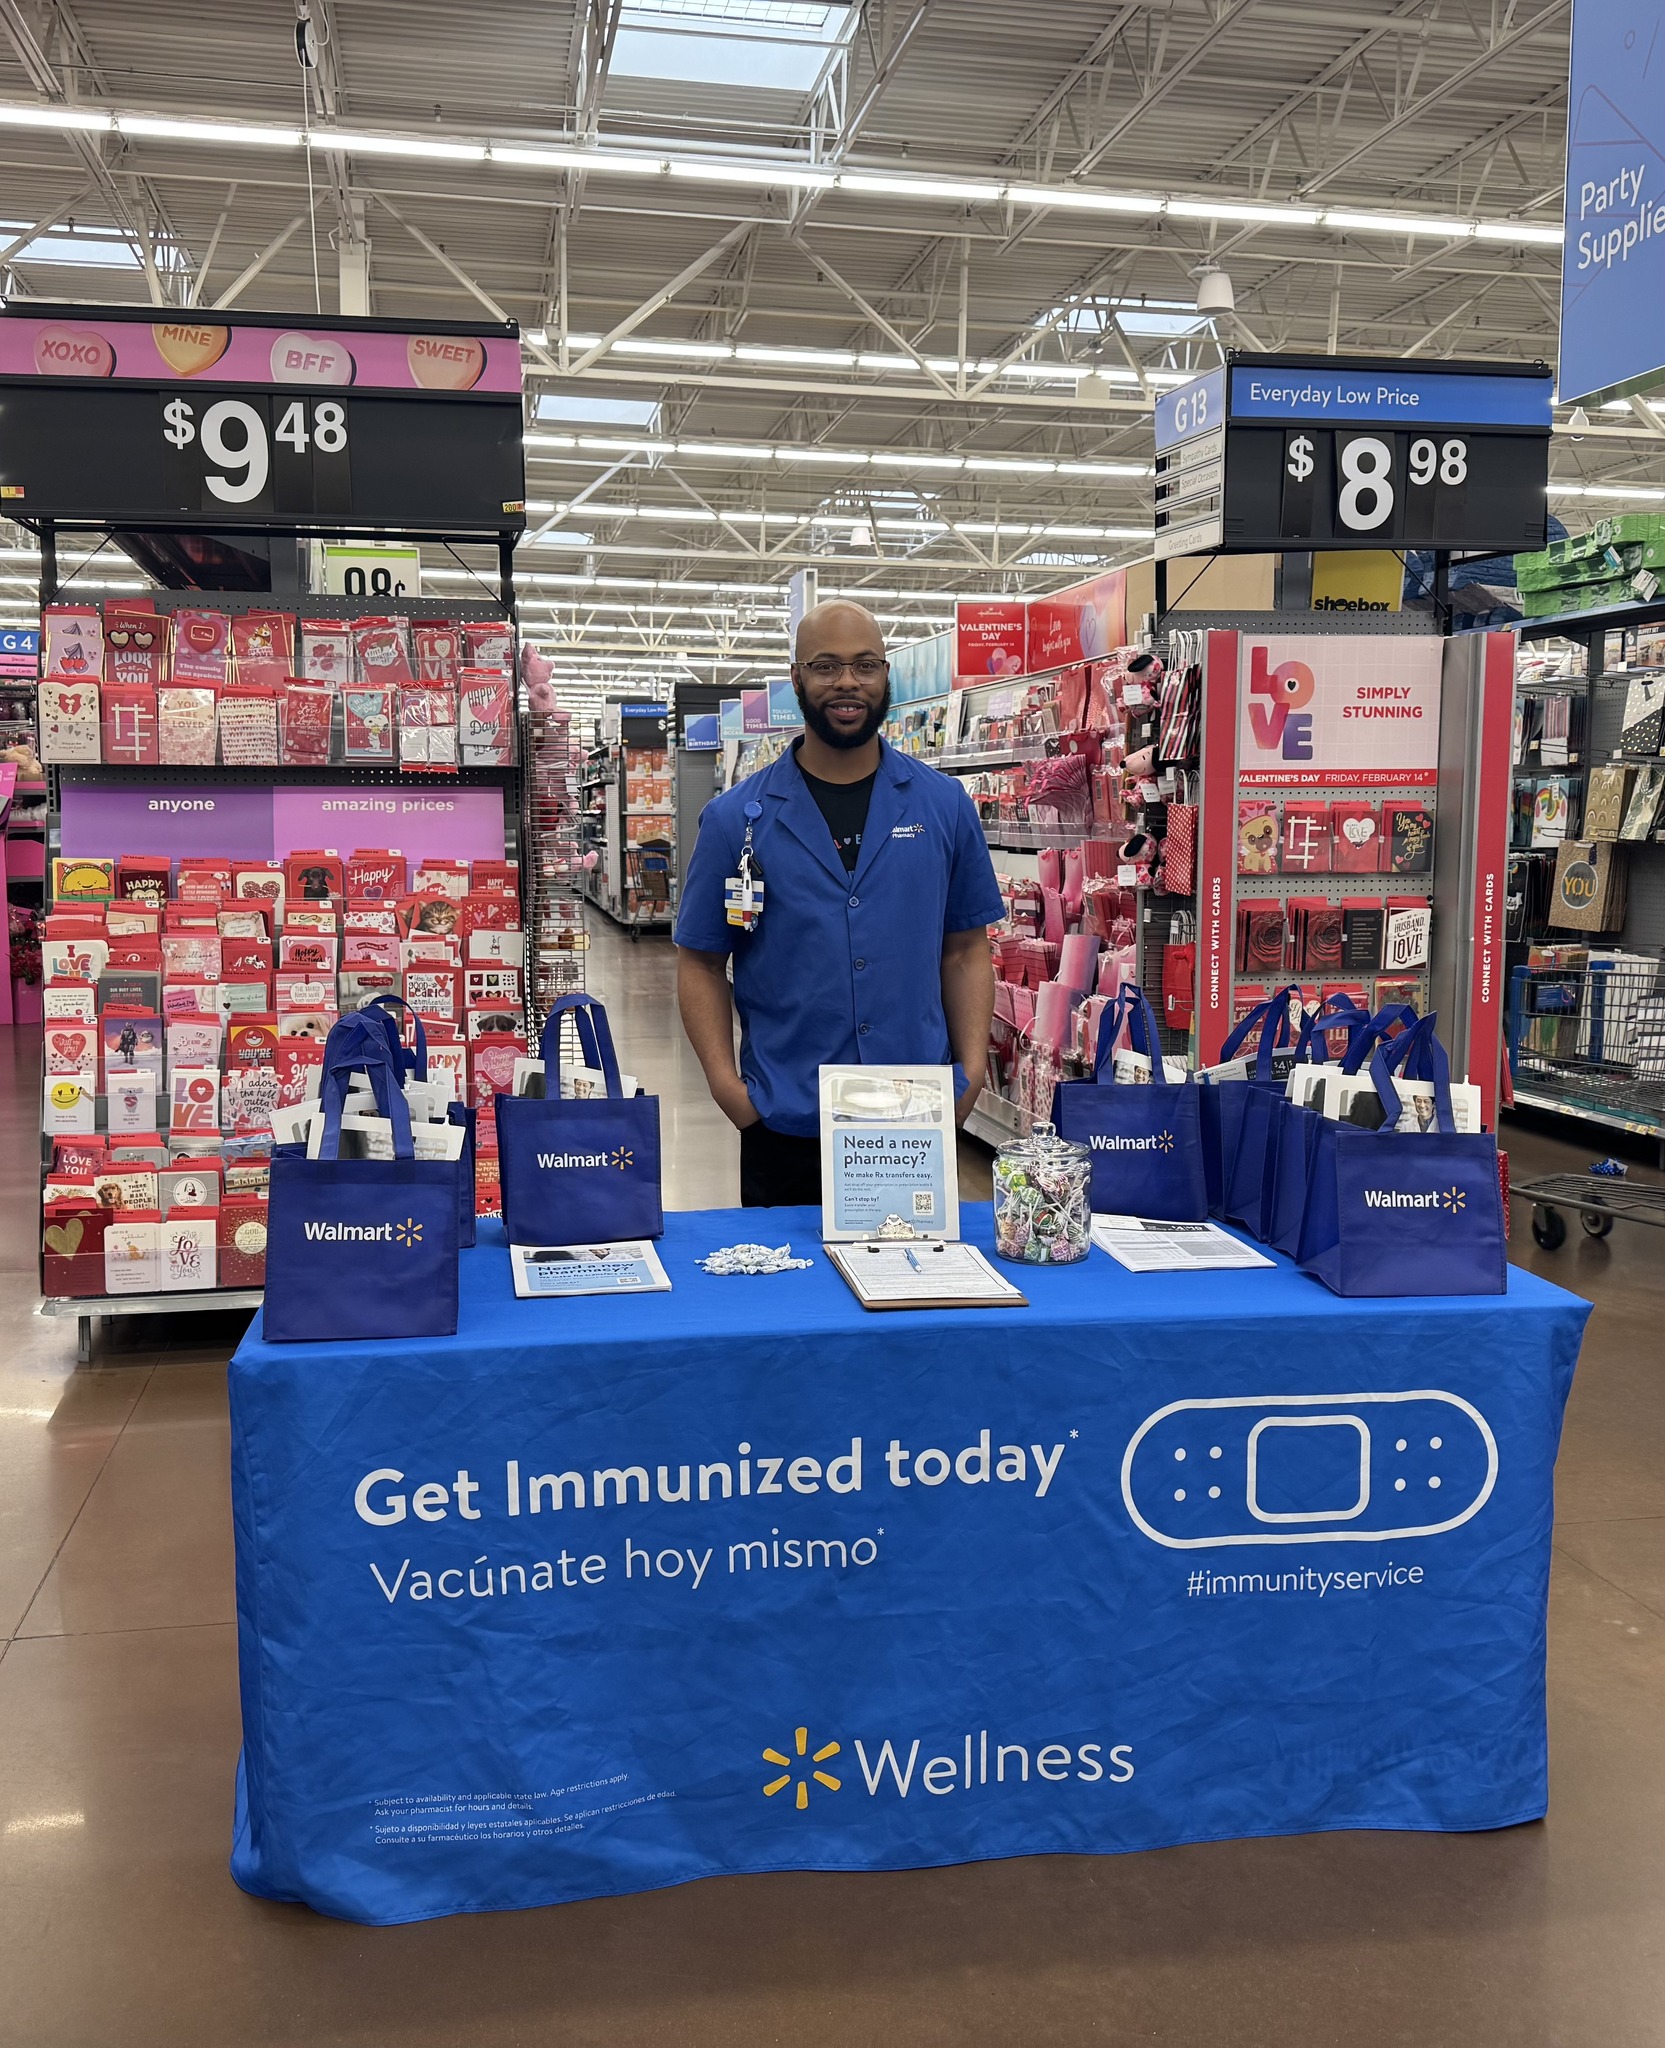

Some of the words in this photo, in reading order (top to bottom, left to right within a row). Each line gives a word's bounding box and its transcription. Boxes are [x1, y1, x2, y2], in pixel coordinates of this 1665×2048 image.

[1579, 163, 1645, 222] Party
[161, 325, 212, 347] MINE
[41, 339, 101, 365] XOXO
[413, 338, 475, 365] SWEET
[284, 349, 335, 374] BFF
[1251, 382, 1331, 407] Everyday
[1336, 384, 1373, 404] Low
[1376, 387, 1420, 406] Price
[1204, 443, 1218, 455] Cards
[1181, 473, 1198, 491] Special
[1198, 469, 1218, 484] Occasion
[1168, 539, 1188, 551] Greeting
[1188, 533, 1203, 545] Cards
[1314, 595, 1391, 612] shoebox
[119, 622, 137, 630] When
[960, 623, 1023, 632] VALENTINE'S
[981, 632, 1001, 641] DAY
[114, 651, 153, 669] LOOK
[179, 662, 194, 670] The
[1356, 686, 1411, 699] SIMPLY
[1342, 706, 1423, 719] STUNNING
[172, 720, 205, 729] LOVED
[657, 719, 666, 731] $
[1239, 773, 1300, 784] VALENTINE'S
[1301, 773, 1320, 783] DAY
[1325, 773, 1360, 784] FRIDAY,
[1362, 772, 1413, 782] FEBRUARY
[148, 799, 215, 814] anyone
[321, 797, 397, 814] amazing
[402, 797, 455, 814] prices
[891, 824, 914, 833] almart
[125, 879, 163, 891] HAPPY
[350, 867, 394, 886] Happy
[1484, 873, 1495, 910] CARDS
[1564, 876, 1596, 897] YOU
[1211, 877, 1221, 915] CARDS
[1394, 915, 1425, 934] HUSBAND,
[1483, 912, 1494, 946] WITH
[1211, 917, 1221, 951] WITH
[66, 945, 75, 957] I
[1393, 932, 1423, 965] LOVE
[53, 953, 91, 975] LOVE
[1211, 954, 1221, 1009] CONNECT
[1482, 949, 1494, 1003] CONNECT
[239, 1047, 274, 1059] YOU'RE
[248, 1077, 279, 1089] adore
[240, 1089, 255, 1098] the
[256, 1089, 277, 1100] hell
[244, 1099, 270, 1108] outta
[844, 1136, 884, 1149] Need
[889, 1139, 897, 1149] a
[902, 1139, 932, 1149] new
[1088, 1134, 1157, 1151] Walmart
[62, 1154, 92, 1167] LOVE
[536, 1151, 609, 1169] Walmart
[844, 1152, 926, 1168] pharmacy?
[64, 1165, 88, 1175] YOU
[124, 1197, 153, 1206] PEOPLE
[1364, 1189, 1440, 1209] Walmart
[303, 1221, 393, 1242] Walmart
[538, 1263, 582, 1271] Need
[538, 1267, 630, 1277] pharmacy?
[354, 1467, 482, 1528] Get
[506, 1436, 864, 1518] Immunized
[369, 1549, 607, 1604] Vacúnate
[625, 1537, 714, 1591] hoy
[1186, 1562, 1426, 1598] #immunityservice
[853, 1729, 1135, 1799] Wellness
[374, 1798, 404, 1807] Subject
[405, 1796, 414, 1804] to
[416, 1794, 457, 1804] availability
[473, 1791, 512, 1802] applicable
[513, 1792, 533, 1800] state
[550, 1788, 566, 1799] Age
[566, 1778, 609, 1794] restrictions
[609, 1772, 630, 1785] apply.
[375, 1808, 389, 1816] Ask
[391, 1808, 409, 1817] your
[410, 1805, 453, 1816] pharmacist
[454, 1803, 467, 1812] for
[468, 1803, 490, 1811] hours
[491, 1802, 506, 1810] and
[507, 1802, 534, 1810] details.
[375, 1825, 400, 1836] Sujeto
[407, 1822, 459, 1834] disponibilidad
[460, 1823, 465, 1831] y
[467, 1821, 487, 1831] leyes
[488, 1818, 523, 1829] estatales
[524, 1816, 562, 1829] aplicables.
[564, 1813, 573, 1822] Se
[574, 1809, 600, 1821] aplican
[601, 1796, 645, 1813] restricciones
[646, 1793, 656, 1801] de
[656, 1790, 677, 1799] edad.
[375, 1836, 409, 1845] Consulte
[428, 1832, 478, 1842] farmacéutico
[480, 1831, 491, 1840] los
[493, 1829, 525, 1840] horarios
[532, 1828, 553, 1836] otros
[554, 1822, 586, 1834] detalles.
